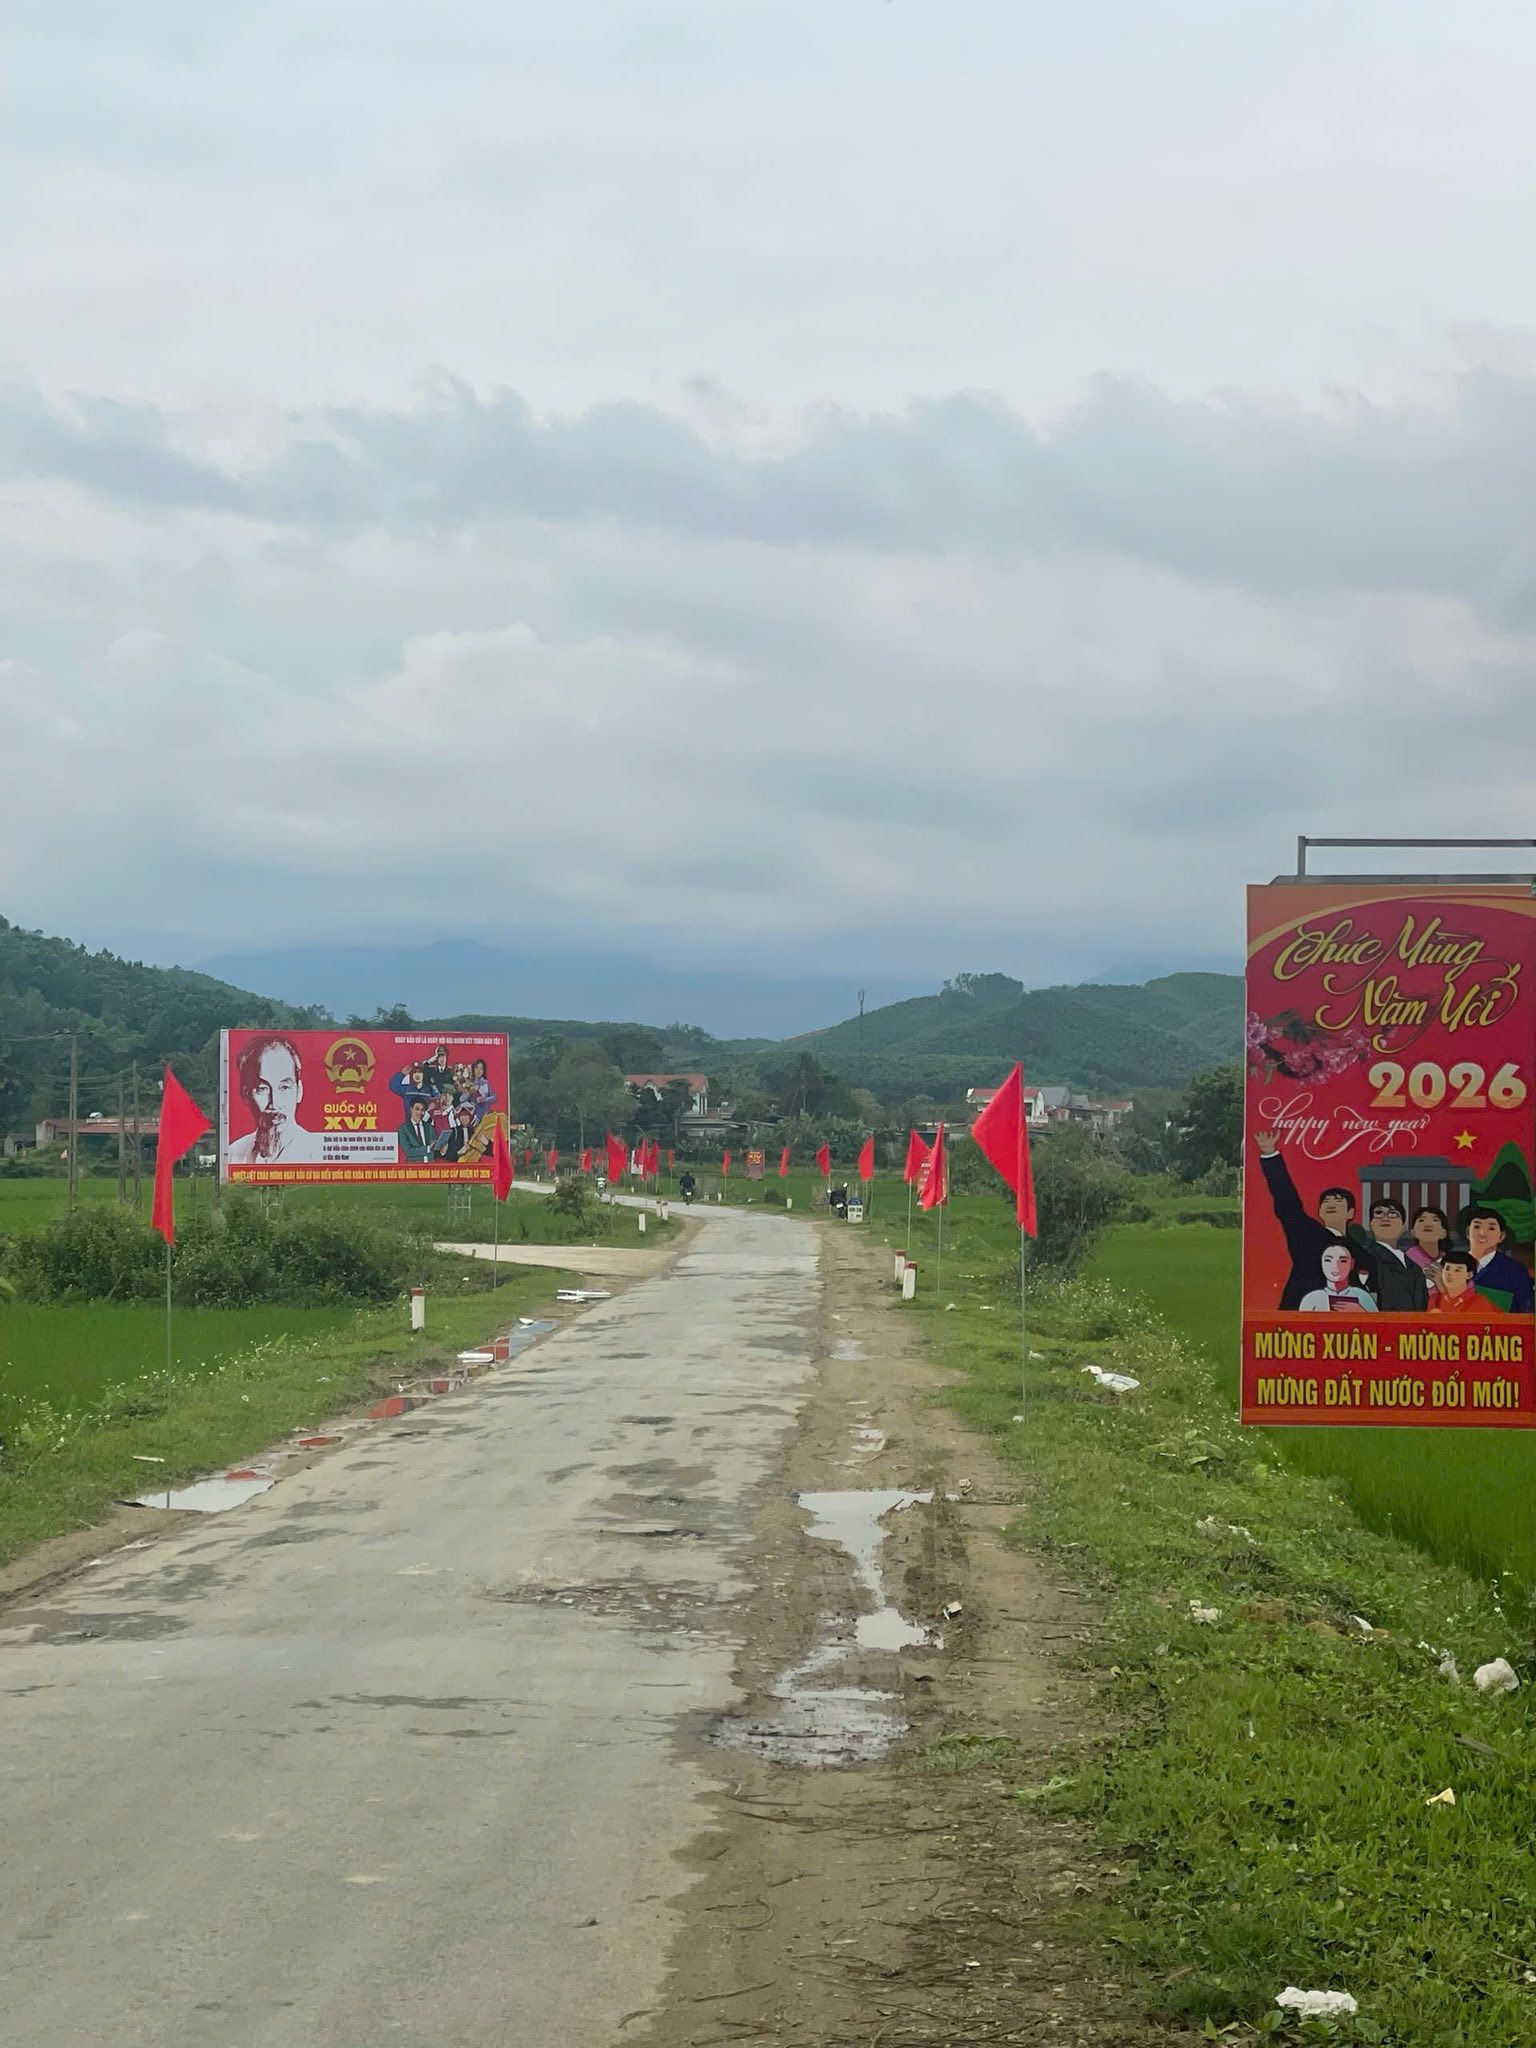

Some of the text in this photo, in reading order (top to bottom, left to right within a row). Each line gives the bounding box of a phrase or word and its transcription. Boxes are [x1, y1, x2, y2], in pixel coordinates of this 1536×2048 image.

[1274, 918, 1383, 980] Chúc
[1368, 1061, 1527, 1110] 2026
[324, 1100, 377, 1116] QUỐC HỘI
[324, 1116, 377, 1130] XVI
[1259, 1092, 1330, 1147] happy
[1255, 1326, 1315, 1359] MỪNG
[1322, 1328, 1378, 1360] XUÂN
[1399, 1328, 1459, 1361] MỪNG
[1466, 1326, 1523, 1362] ĐẢNG
[1257, 1370, 1520, 1408] MỪNG ĐẤT NƯỚC ĐỔI MỚI!
